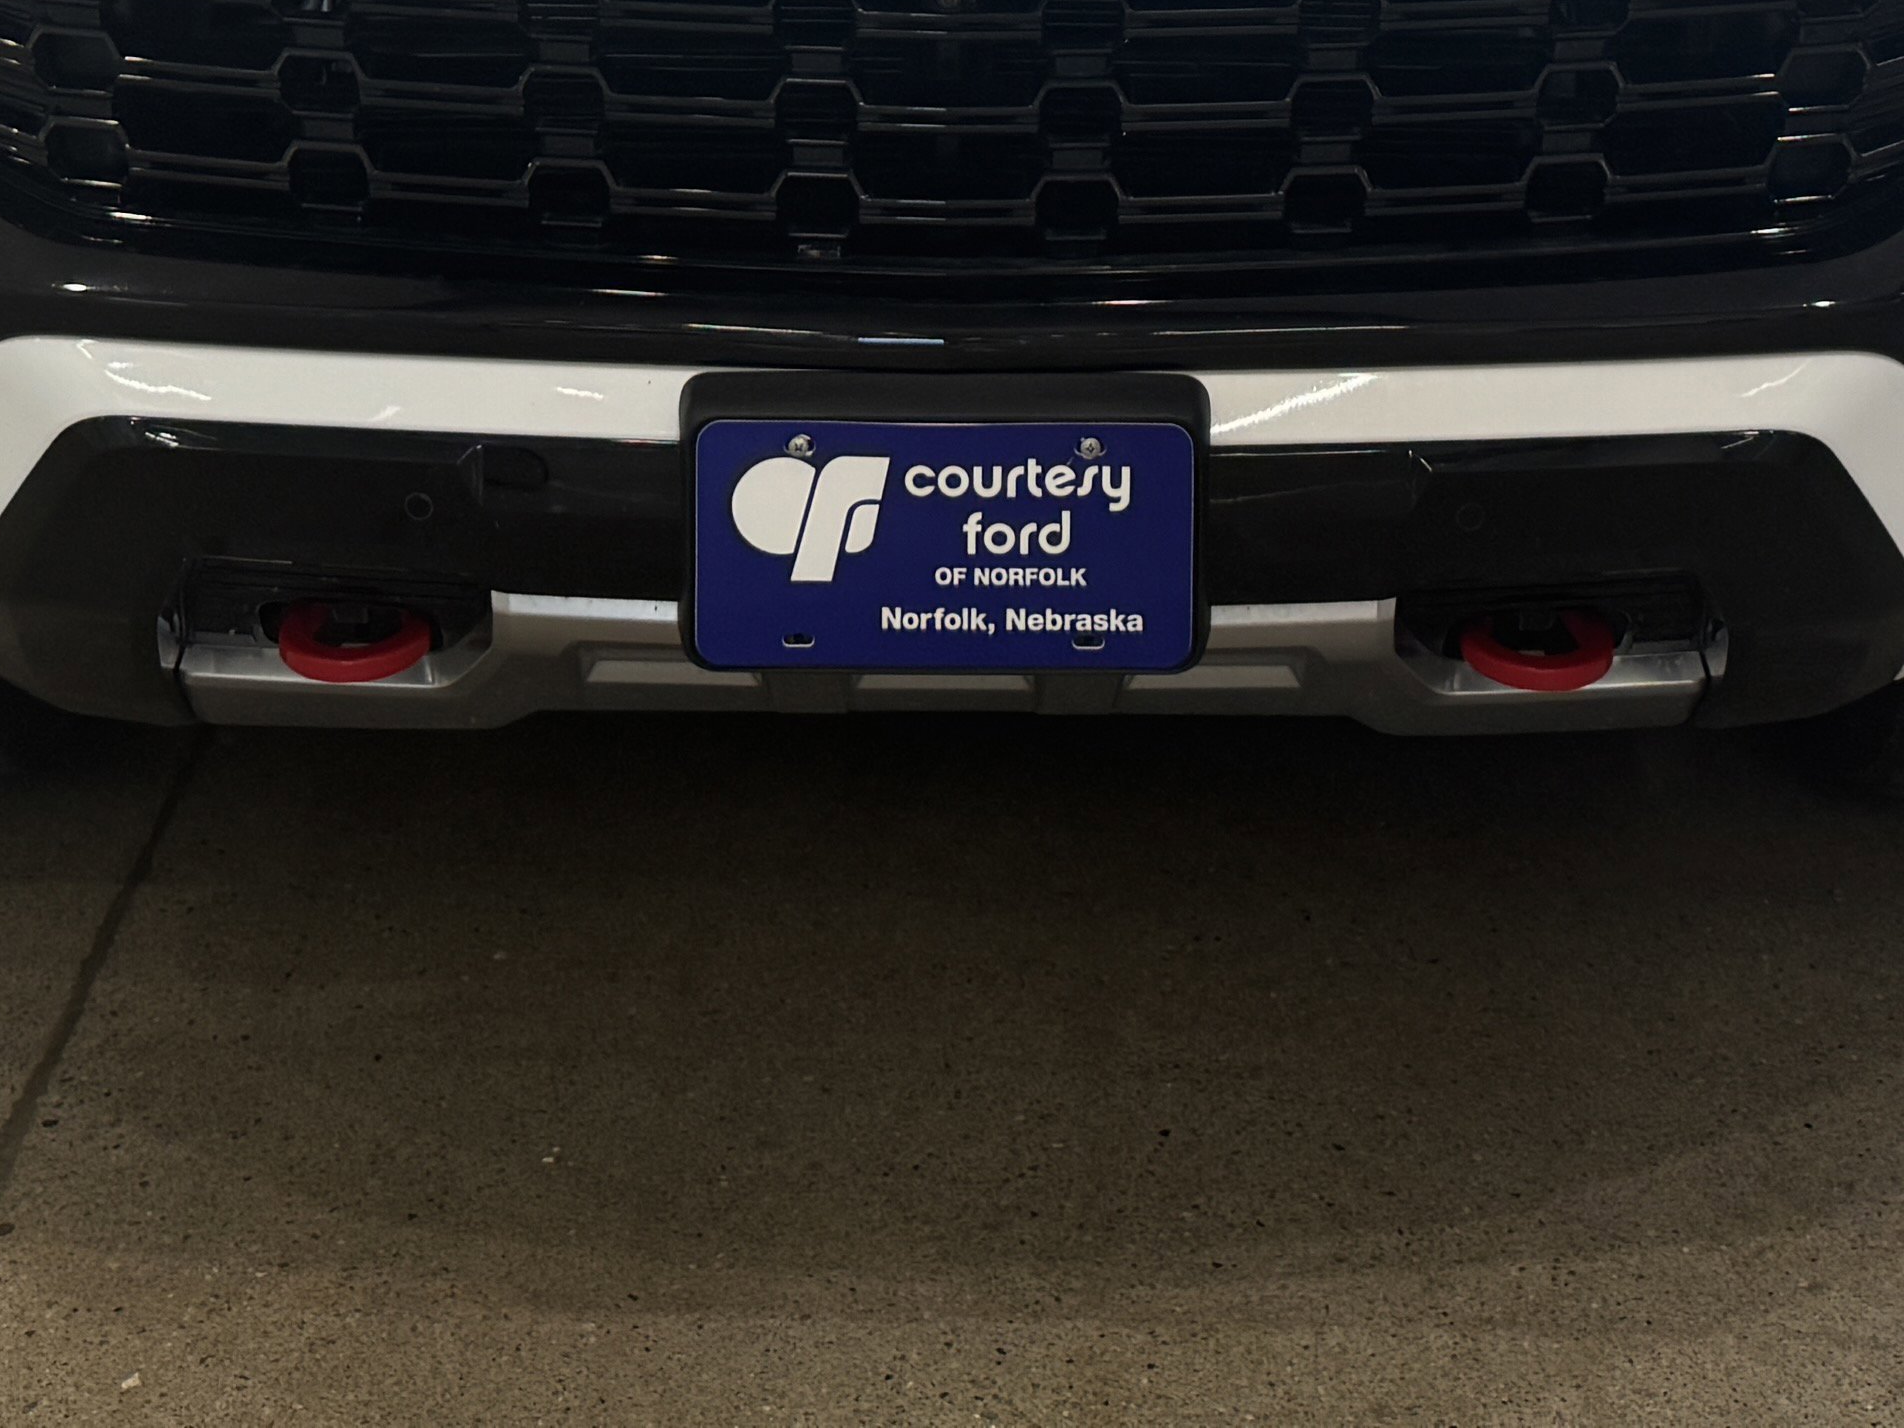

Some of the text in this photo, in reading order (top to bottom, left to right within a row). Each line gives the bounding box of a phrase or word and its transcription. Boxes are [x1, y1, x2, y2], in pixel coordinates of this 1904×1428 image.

[903, 458, 1132, 512] courtesy
[962, 510, 1072, 556] ford
[934, 567, 1087, 587] OF NORFOLK
[880, 606, 1145, 635] Norfolk, Nebraska
